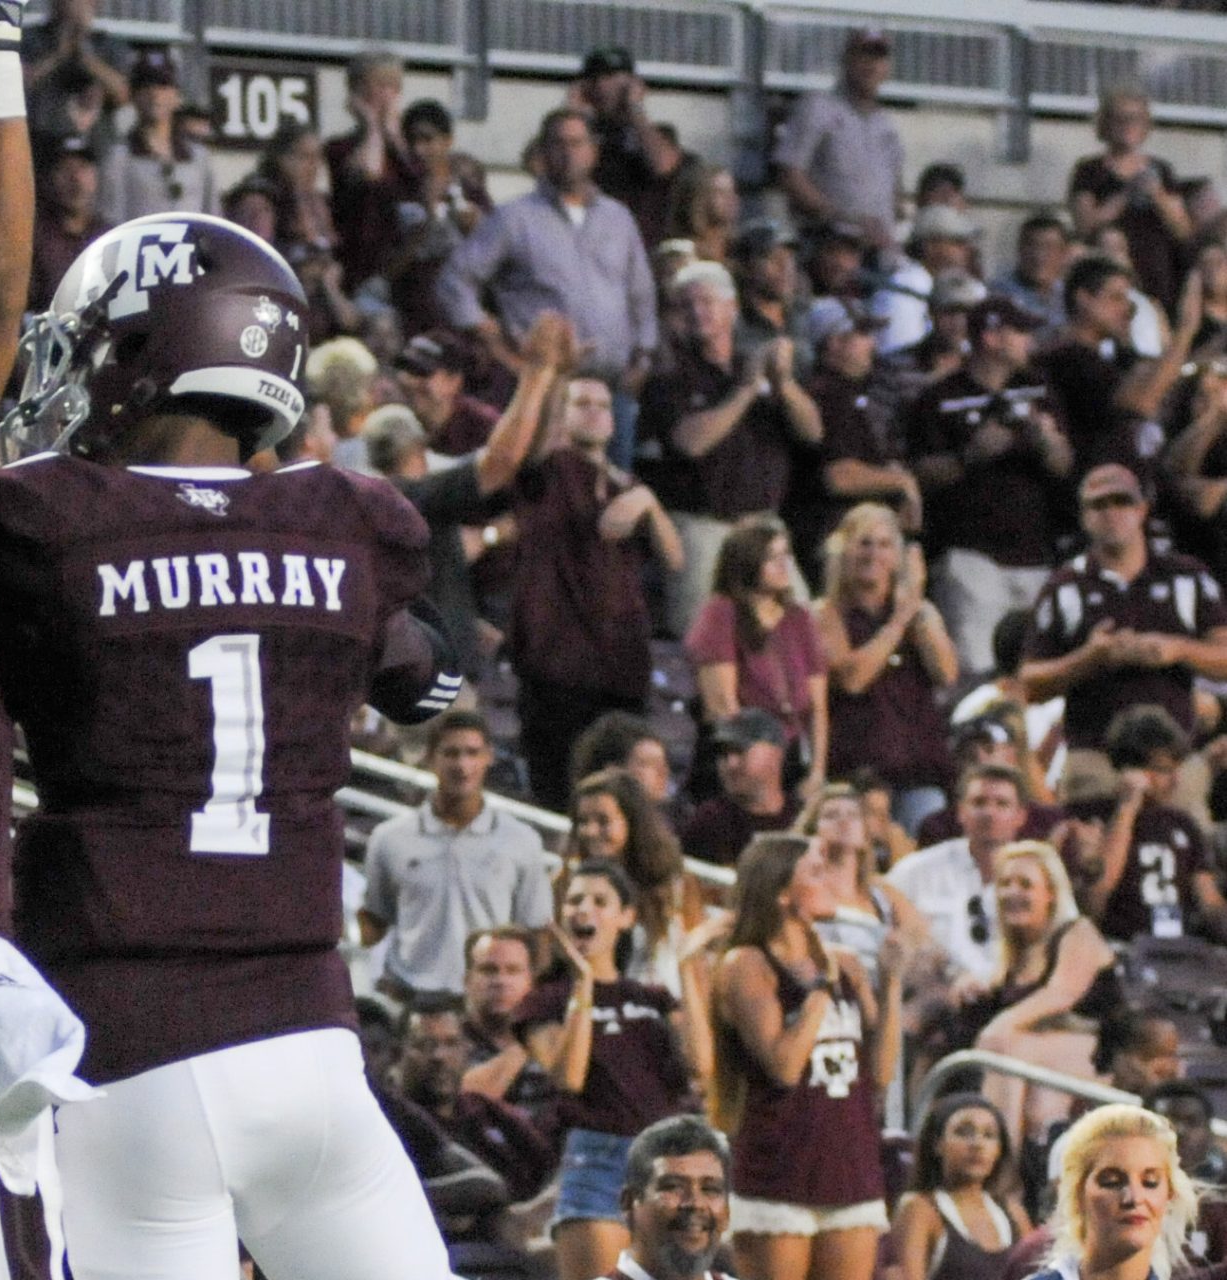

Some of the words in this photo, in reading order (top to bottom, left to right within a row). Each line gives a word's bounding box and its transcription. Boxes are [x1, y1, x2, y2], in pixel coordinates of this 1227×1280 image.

[217, 75, 310, 138] 105
[97, 551, 347, 617] MURRAY
[187, 633, 271, 855] 1
